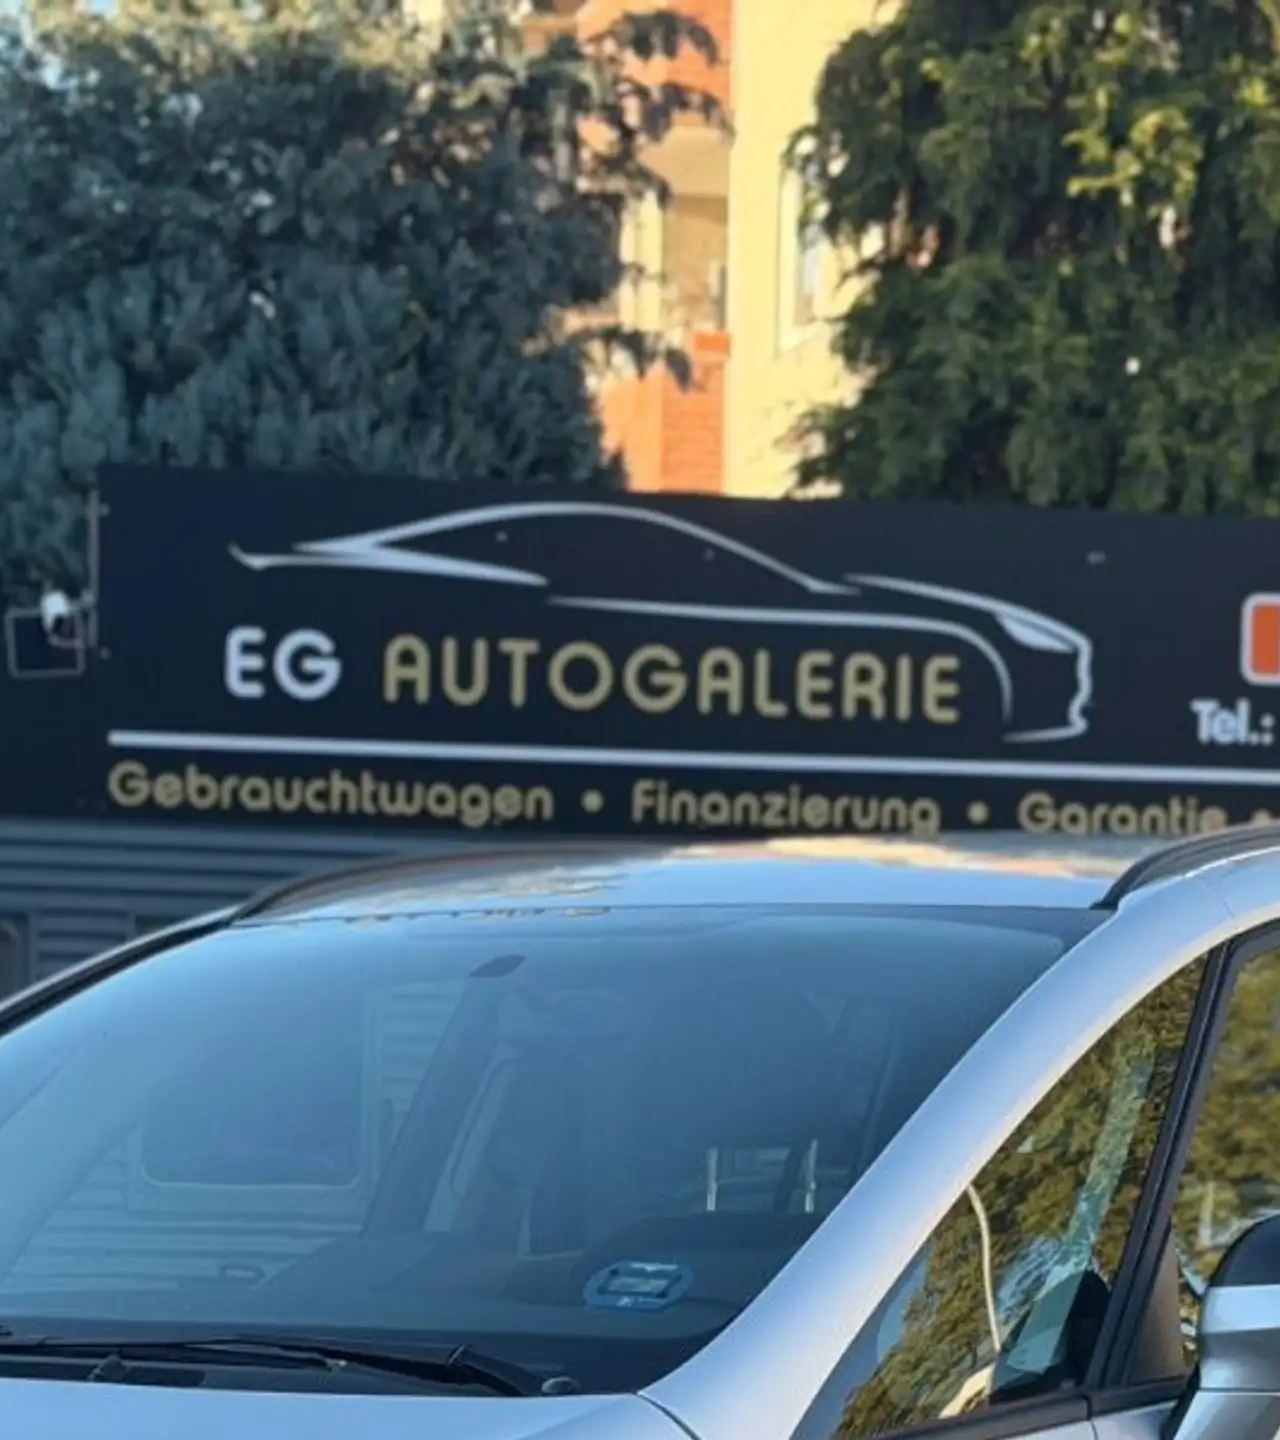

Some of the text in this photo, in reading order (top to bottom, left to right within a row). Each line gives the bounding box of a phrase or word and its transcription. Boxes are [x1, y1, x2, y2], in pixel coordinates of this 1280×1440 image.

[224, 625, 961, 724] EG AUTOGALERIE
[1190, 699, 1275, 746] Tel.:
[108, 761, 554, 829] Gebrauchtwagen
[631, 778, 942, 839] Finanzierung
[1017, 790, 1229, 836] Garantie
